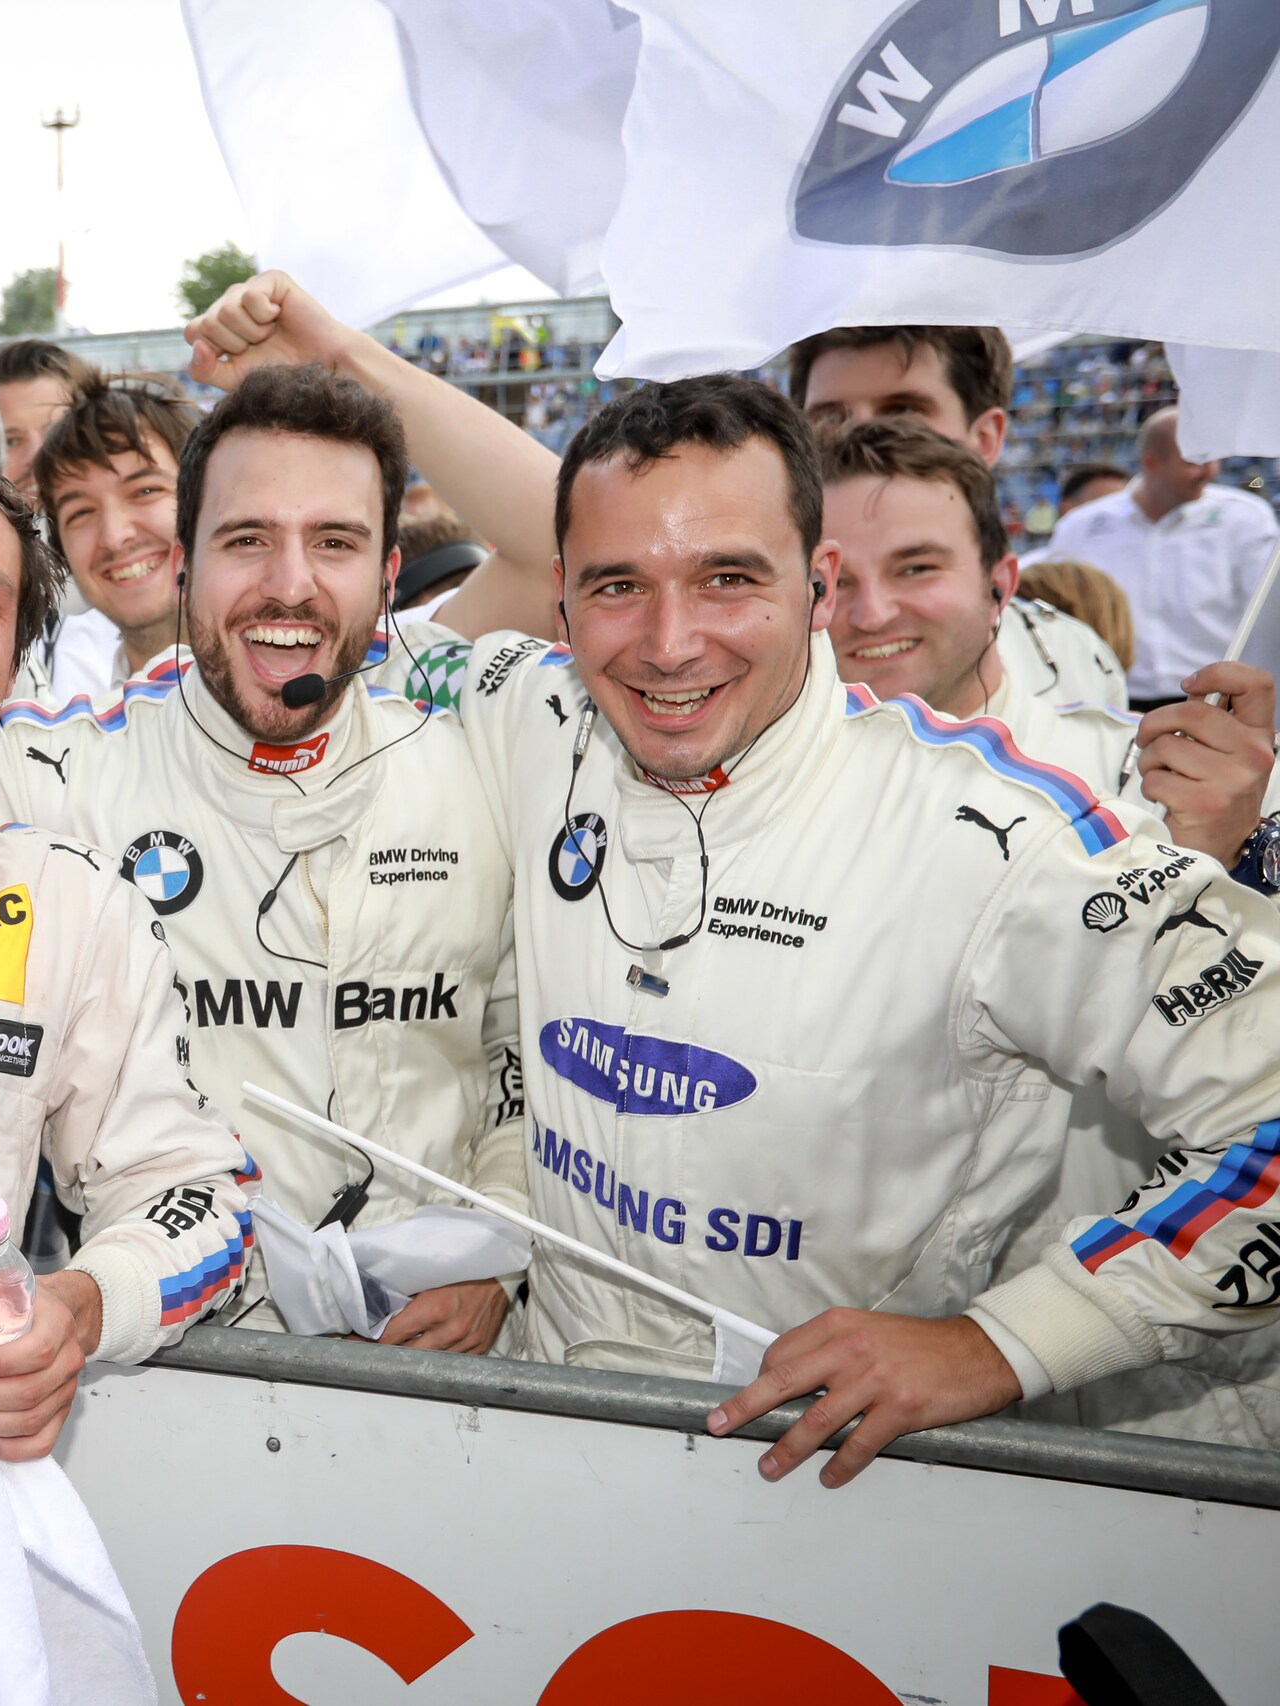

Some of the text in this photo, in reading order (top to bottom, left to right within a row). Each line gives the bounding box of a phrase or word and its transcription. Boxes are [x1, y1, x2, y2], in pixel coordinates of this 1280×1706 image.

[476, 648, 510, 694] ULTRA
[253, 755, 311, 773] PUMA
[124, 831, 195, 863] BMW
[369, 848, 459, 866] BMW Driving
[369, 867, 449, 886] Experience
[713, 896, 828, 932] BMW Driving
[707, 917, 805, 949] Experience
[177, 972, 460, 1031] MW Bank
[1152, 964, 1245, 1027] H&R
[556, 1016, 718, 1112] SAMSUNG
[704, 1206, 803, 1261] SDI
